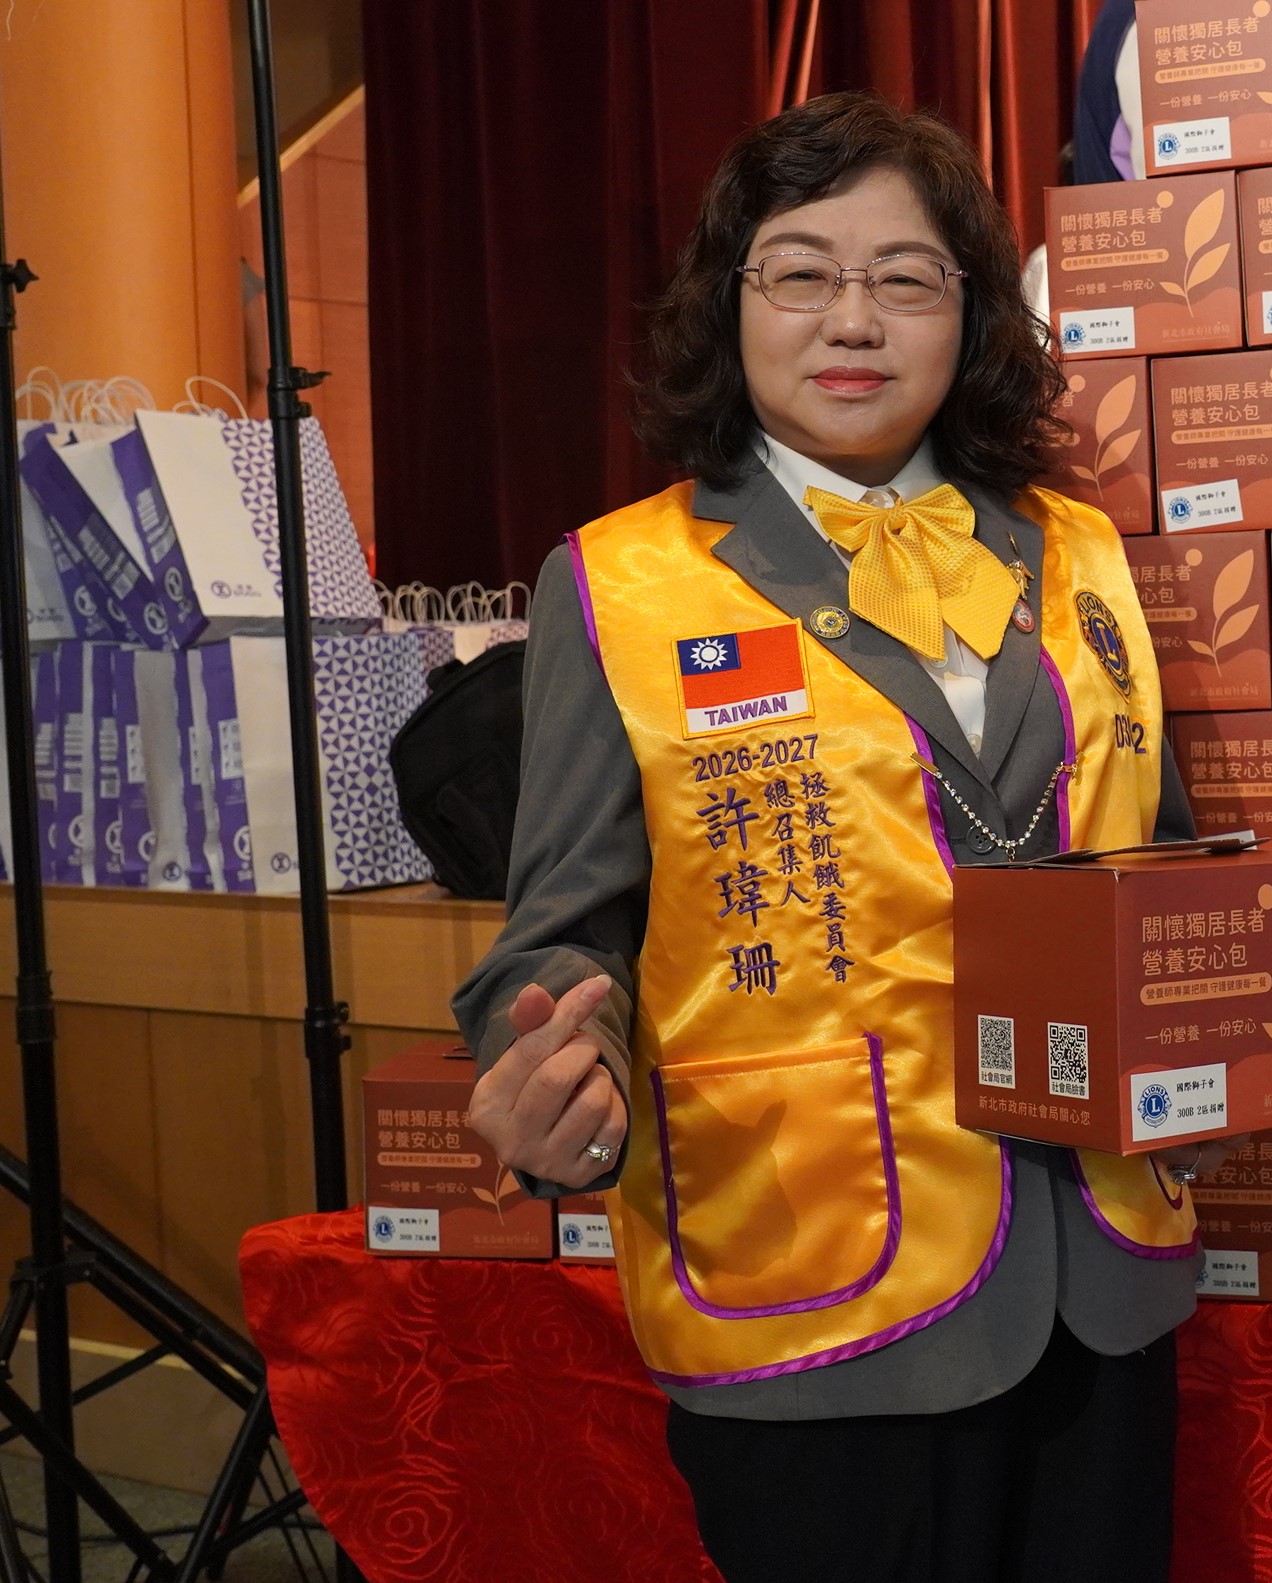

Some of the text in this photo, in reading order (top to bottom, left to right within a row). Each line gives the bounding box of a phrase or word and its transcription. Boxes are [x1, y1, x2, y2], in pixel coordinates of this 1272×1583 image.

[1155, 15, 1259, 44] 關懷獨居長者
[1156, 38, 1243, 65] 營養安心包
[1158, 89, 1252, 108] 一份營養 一份安心
[1061, 206, 1162, 232] 關懷獨居長者
[1062, 229, 1146, 253] 營養安心包
[1064, 278, 1155, 295] 一份營養 一份安心
[1172, 403, 1260, 426] 營養安心包
[1175, 454, 1269, 469] 一份營養 一份安心
[1080, 596, 1113, 625] LIONS
[705, 695, 788, 727] TAIWAN
[1115, 714, 1147, 754] D32
[692, 733, 819, 783] 2026-2027
[764, 778, 810, 907] 總召集人
[800, 771, 854, 984] 拯救飢餓委員會
[696, 787, 780, 996] 許瑋珊
[1142, 907, 1266, 943] 關懷獨居長者
[1143, 941, 1247, 977] 營養安心包
[1146, 976, 1266, 1000] 營養師專業把關 守護健康每一餐
[1145, 1017, 1256, 1047] 一份營養 一份安心
[982, 1071, 1012, 1085] 社會局官網
[1052, 1082, 1086, 1096] 社會局臉書
[1144, 1086, 1164, 1096] LIONS
[1176, 1078, 1215, 1092] 國際獅子會
[979, 1096, 1090, 1126] 新北市政府社會局關心您
[1177, 1102, 1224, 1118] 300B 2區捐贈
